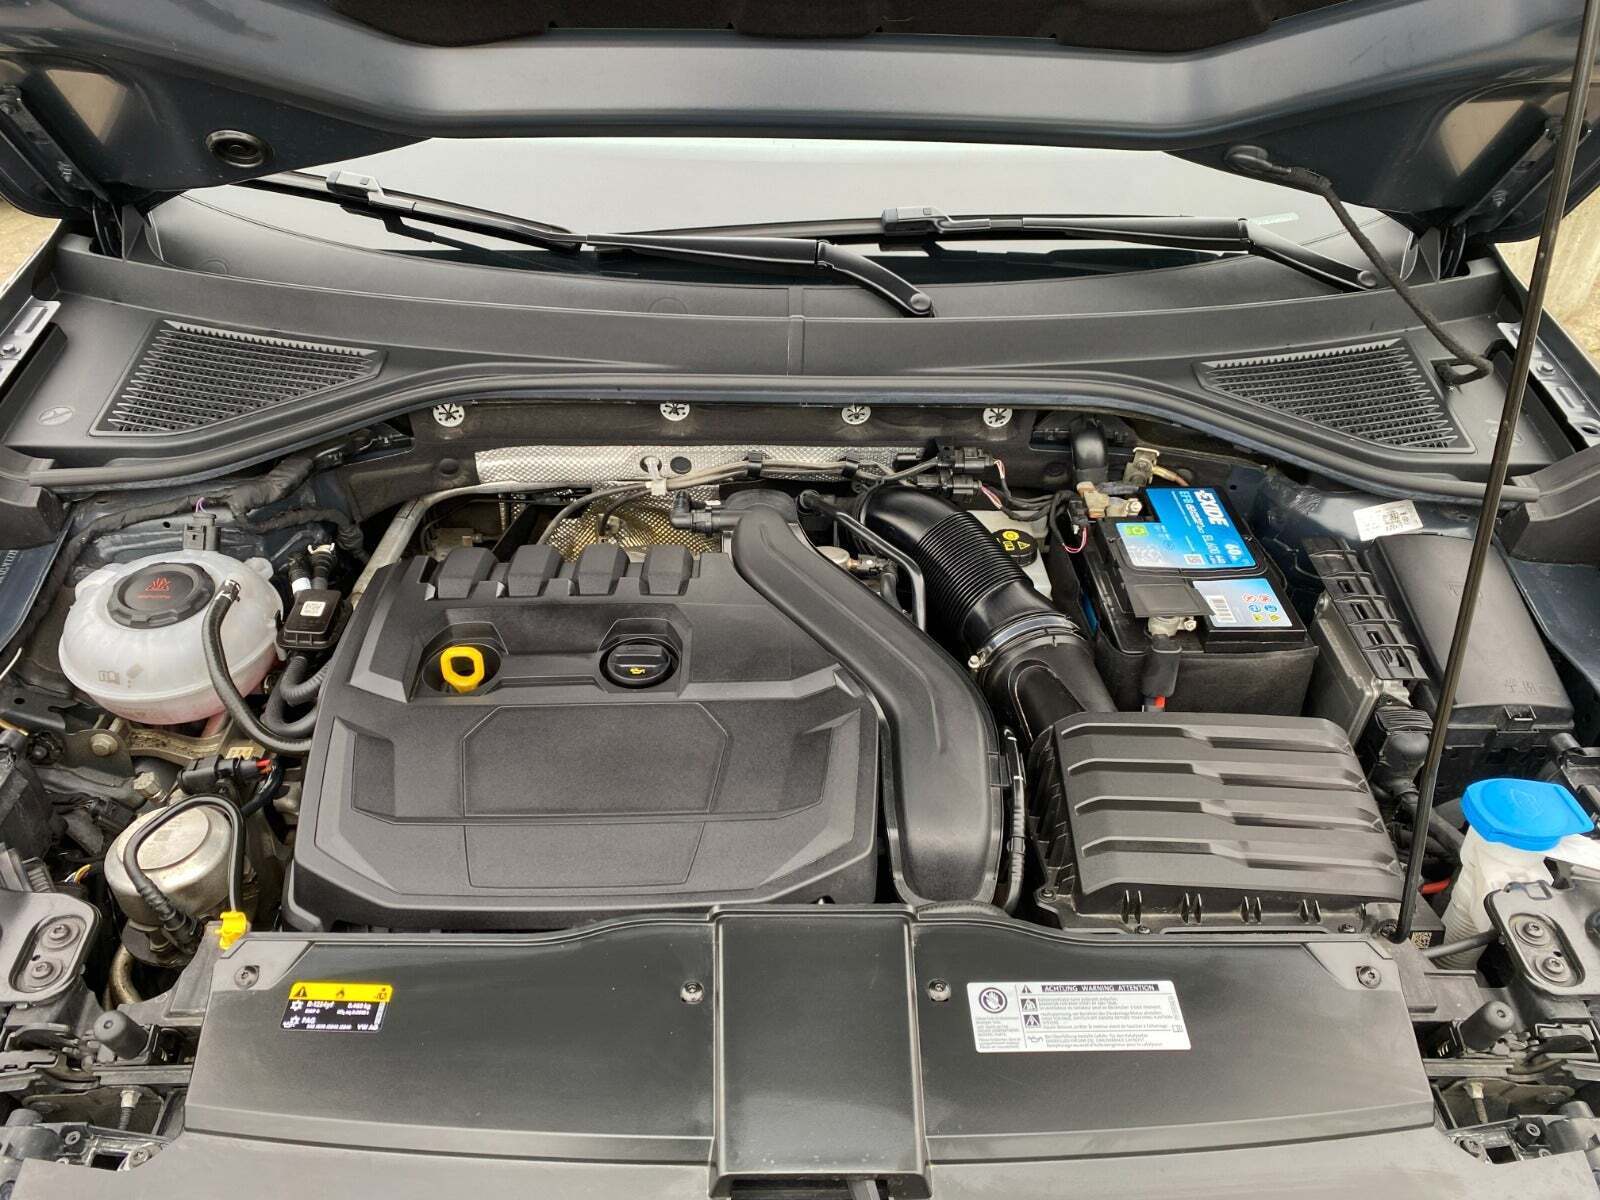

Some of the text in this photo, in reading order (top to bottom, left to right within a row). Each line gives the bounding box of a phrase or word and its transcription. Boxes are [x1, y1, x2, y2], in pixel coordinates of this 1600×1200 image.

[1194, 490, 1229, 527] EXIDE
[1044, 984, 1155, 992] ACHTUNG WARNING ATTENTION
